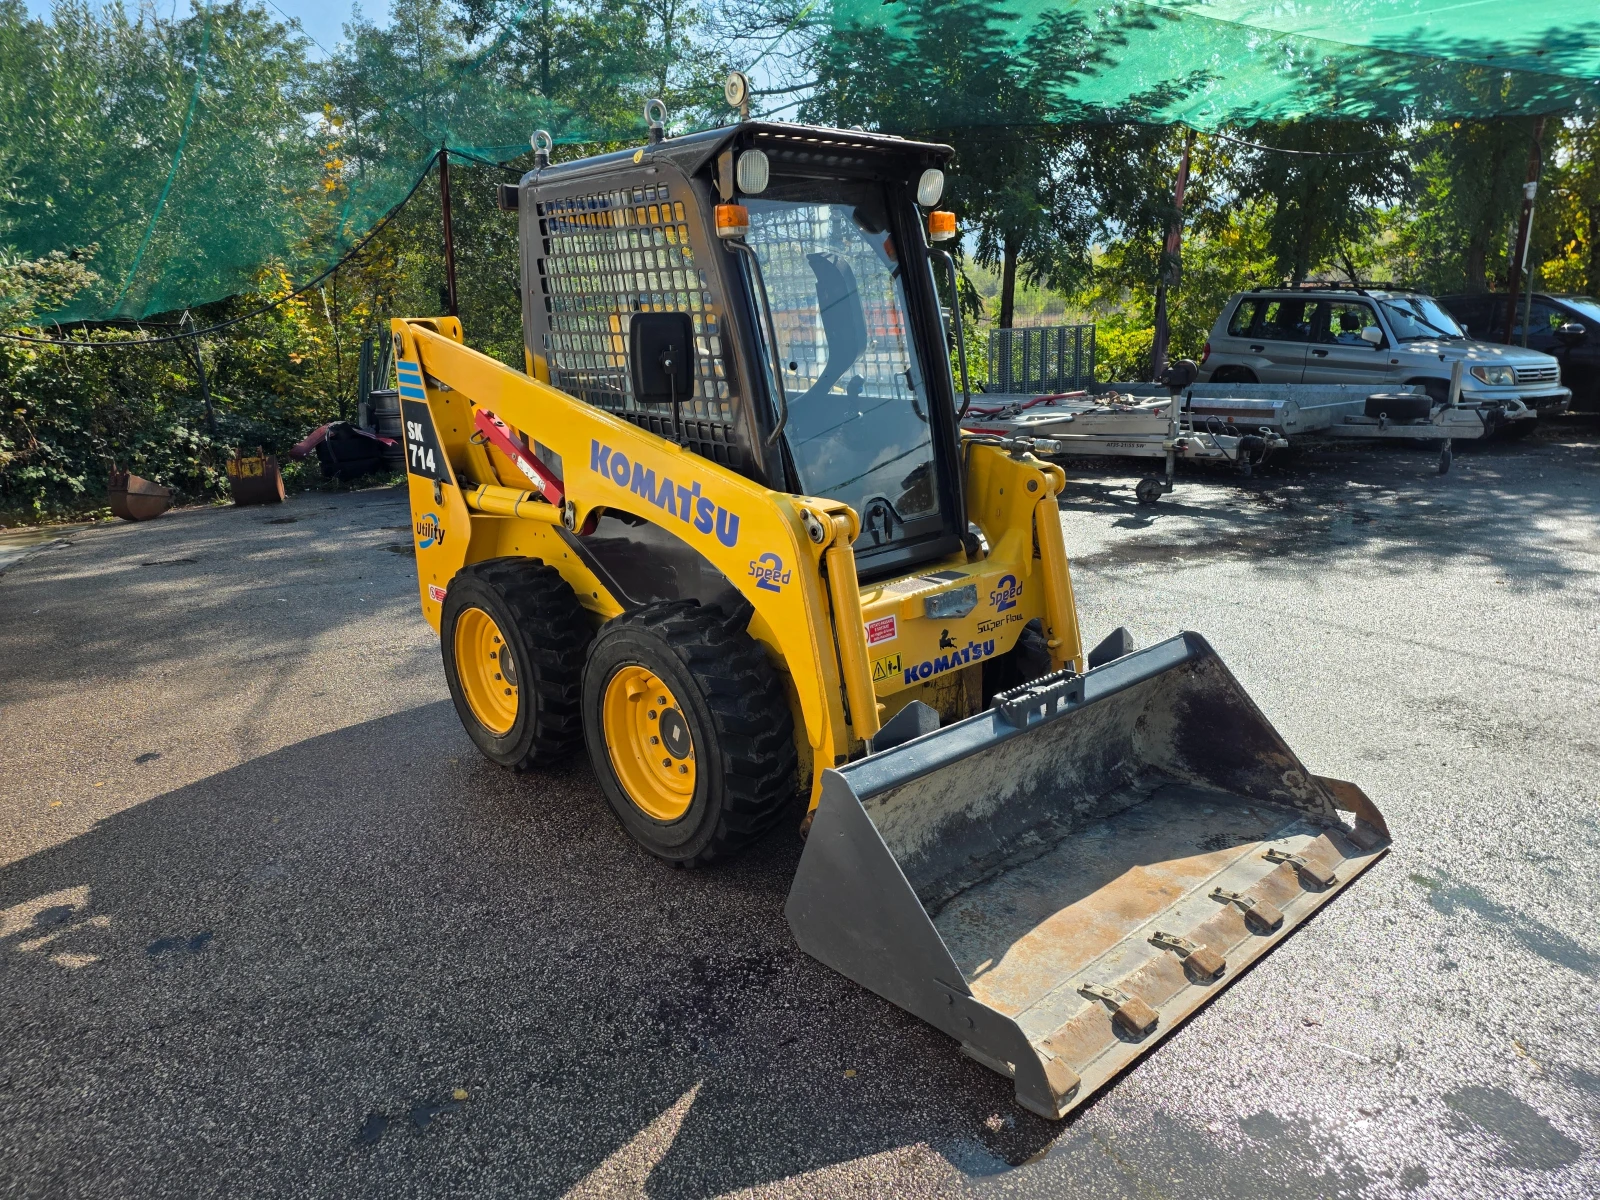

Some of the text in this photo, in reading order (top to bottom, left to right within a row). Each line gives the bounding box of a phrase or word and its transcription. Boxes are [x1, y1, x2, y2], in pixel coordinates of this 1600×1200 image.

[407, 421, 424, 442] SK
[409, 444, 436, 473] 714
[590, 439, 740, 547] KOMATSU
[416, 522, 446, 546] Utility
[748, 553, 792, 593] 2 Speed
[989, 574, 1023, 613] 2 Speed
[977, 618, 1005, 634] Super
[904, 639, 995, 685] KOMATSU
